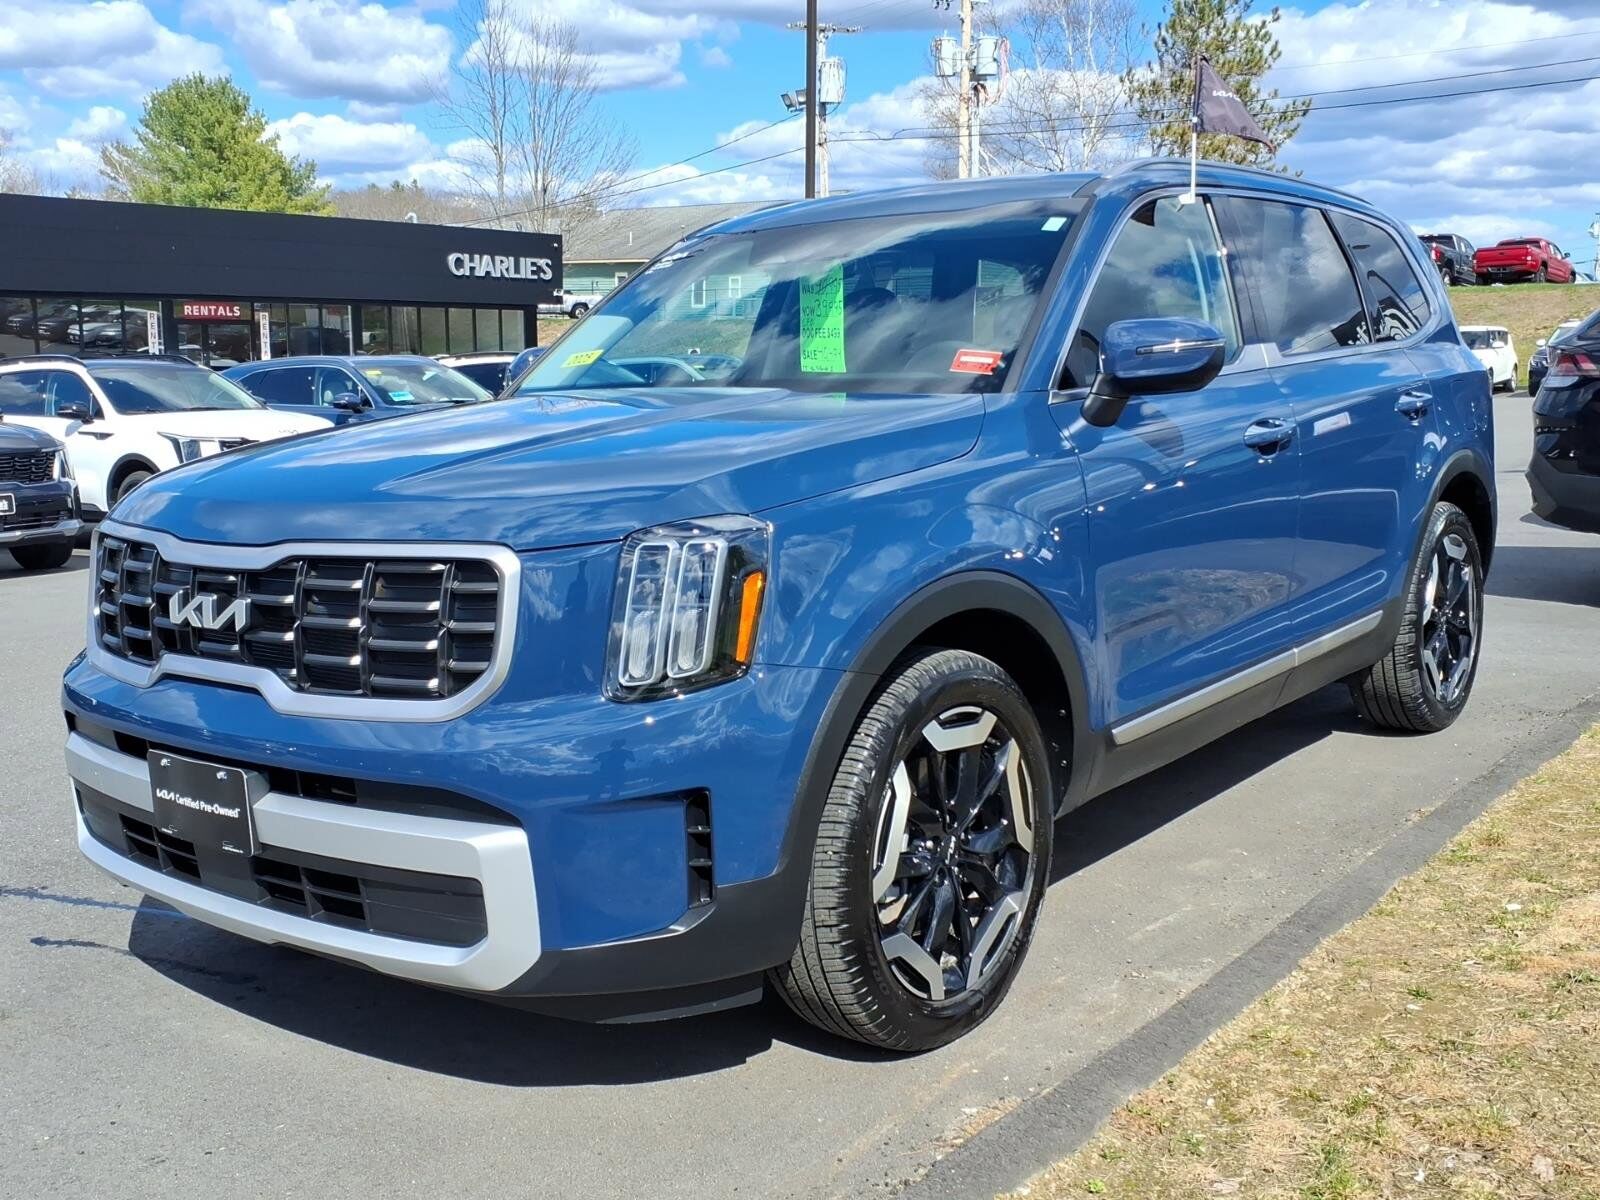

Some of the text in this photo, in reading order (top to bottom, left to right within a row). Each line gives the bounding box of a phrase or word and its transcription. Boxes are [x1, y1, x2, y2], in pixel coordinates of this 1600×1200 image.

[447, 252, 553, 280] CHARLIE'S
[183, 305, 241, 316] RENTALS
[169, 589, 251, 632] KIA
[156, 788, 175, 801] KIA
[175, 794, 199, 810] Certified
